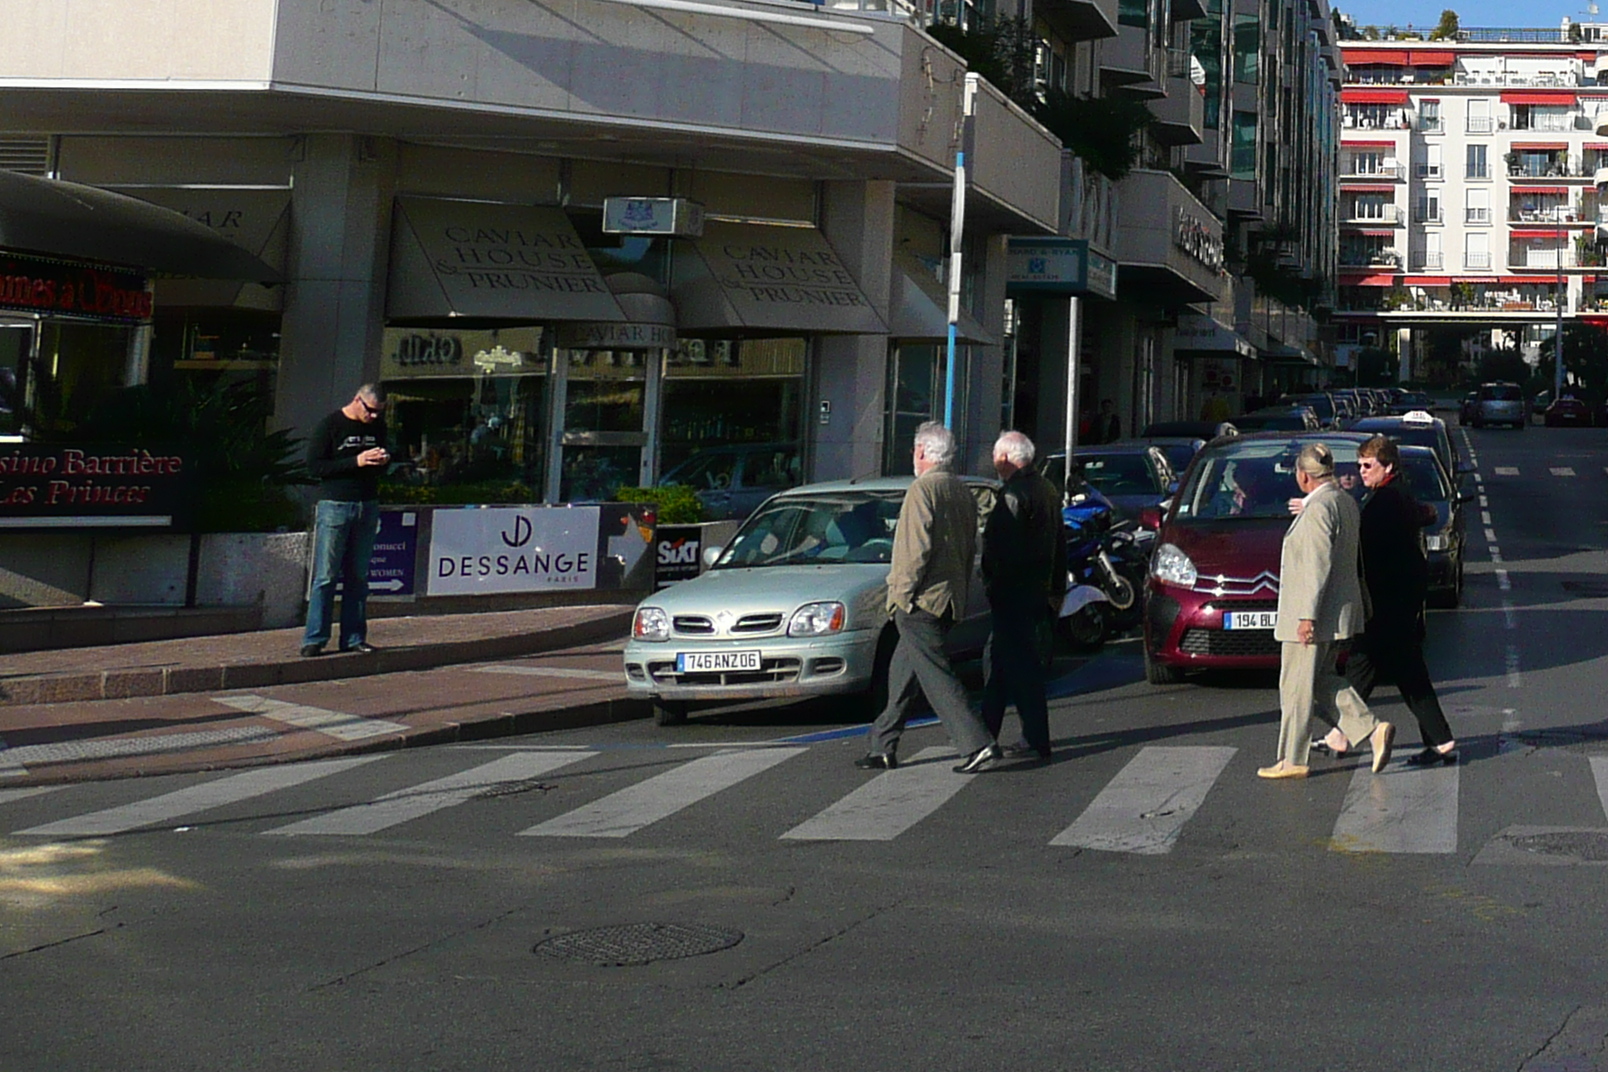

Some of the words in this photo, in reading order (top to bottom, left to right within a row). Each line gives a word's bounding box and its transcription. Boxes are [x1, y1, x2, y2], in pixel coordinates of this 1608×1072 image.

[446, 229, 581, 249] CAVIAR
[456, 248, 593, 269] HOUSE
[723, 245, 839, 266] CAVIAR
[468, 273, 607, 293] PRUNIER
[735, 265, 850, 285] HOUSE
[749, 287, 867, 307] PRUNIER
[61, 448, 182, 475] Barrière
[44, 480, 151, 505] Princes
[438, 553, 589, 578] DESSANGE
[1236, 614, 1257, 628] 194
